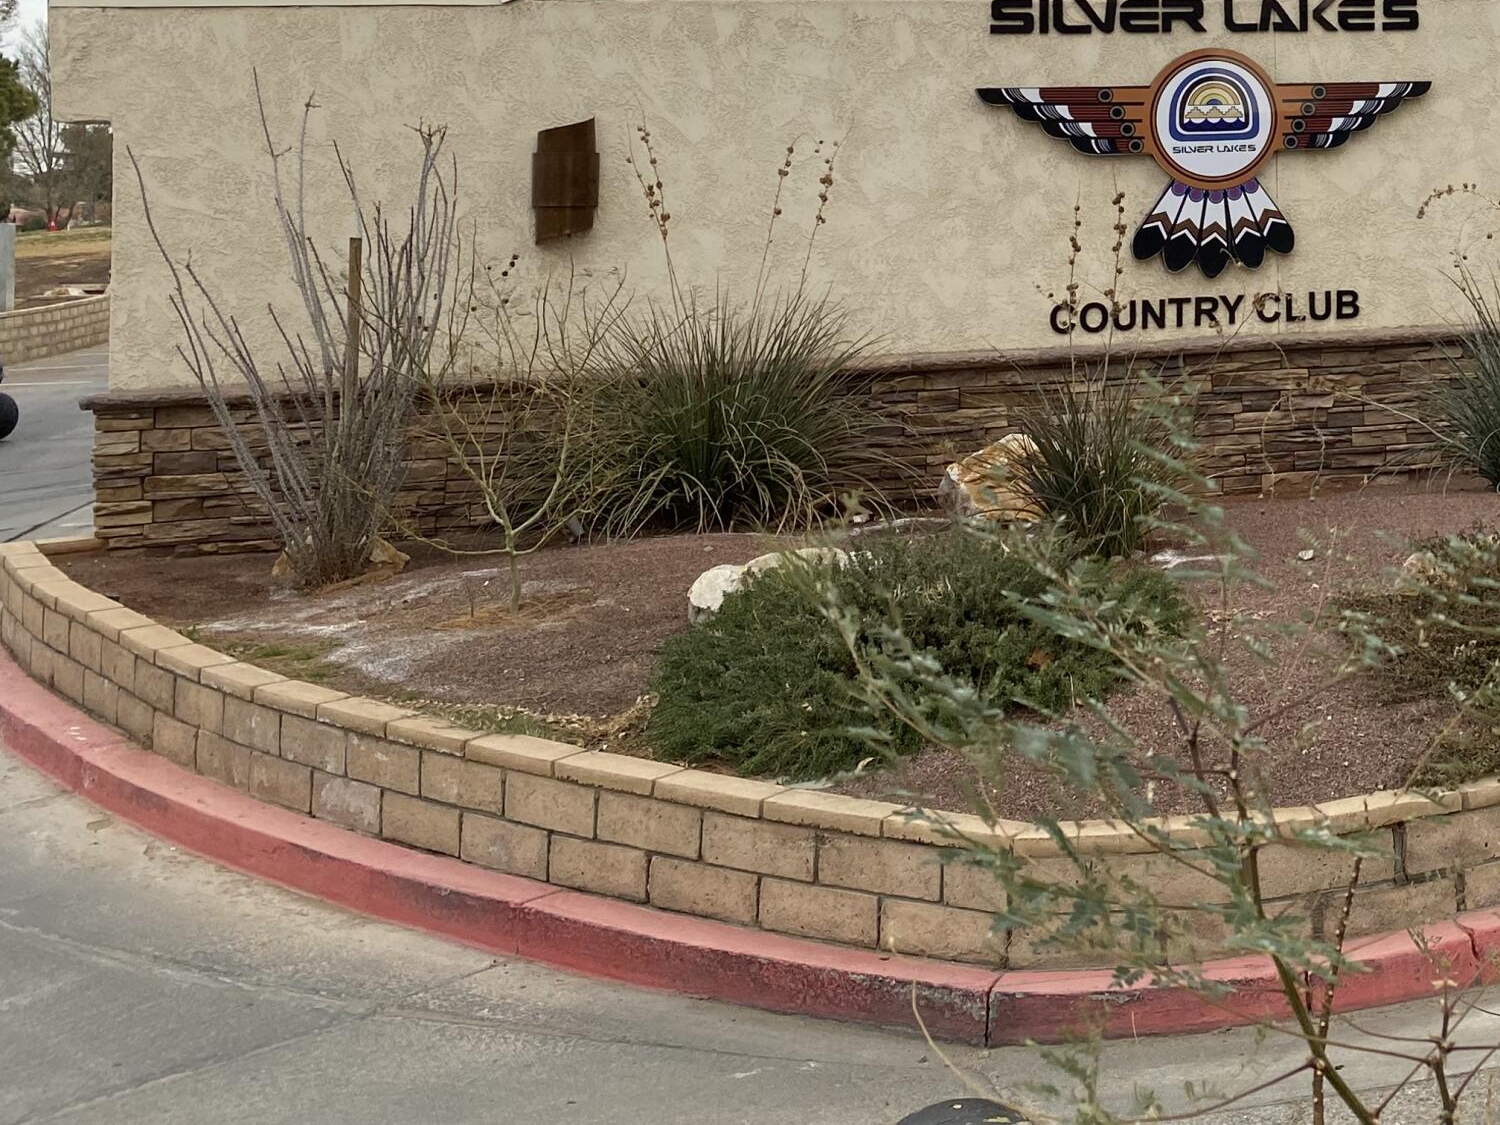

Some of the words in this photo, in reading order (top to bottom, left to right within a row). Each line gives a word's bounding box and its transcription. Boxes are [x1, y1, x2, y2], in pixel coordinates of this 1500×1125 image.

[1172, 145, 1214, 154] SILVER
[1217, 144, 1256, 153] LAKES
[1050, 294, 1245, 335] COUNTRY
[1255, 289, 1360, 324] CLUB
